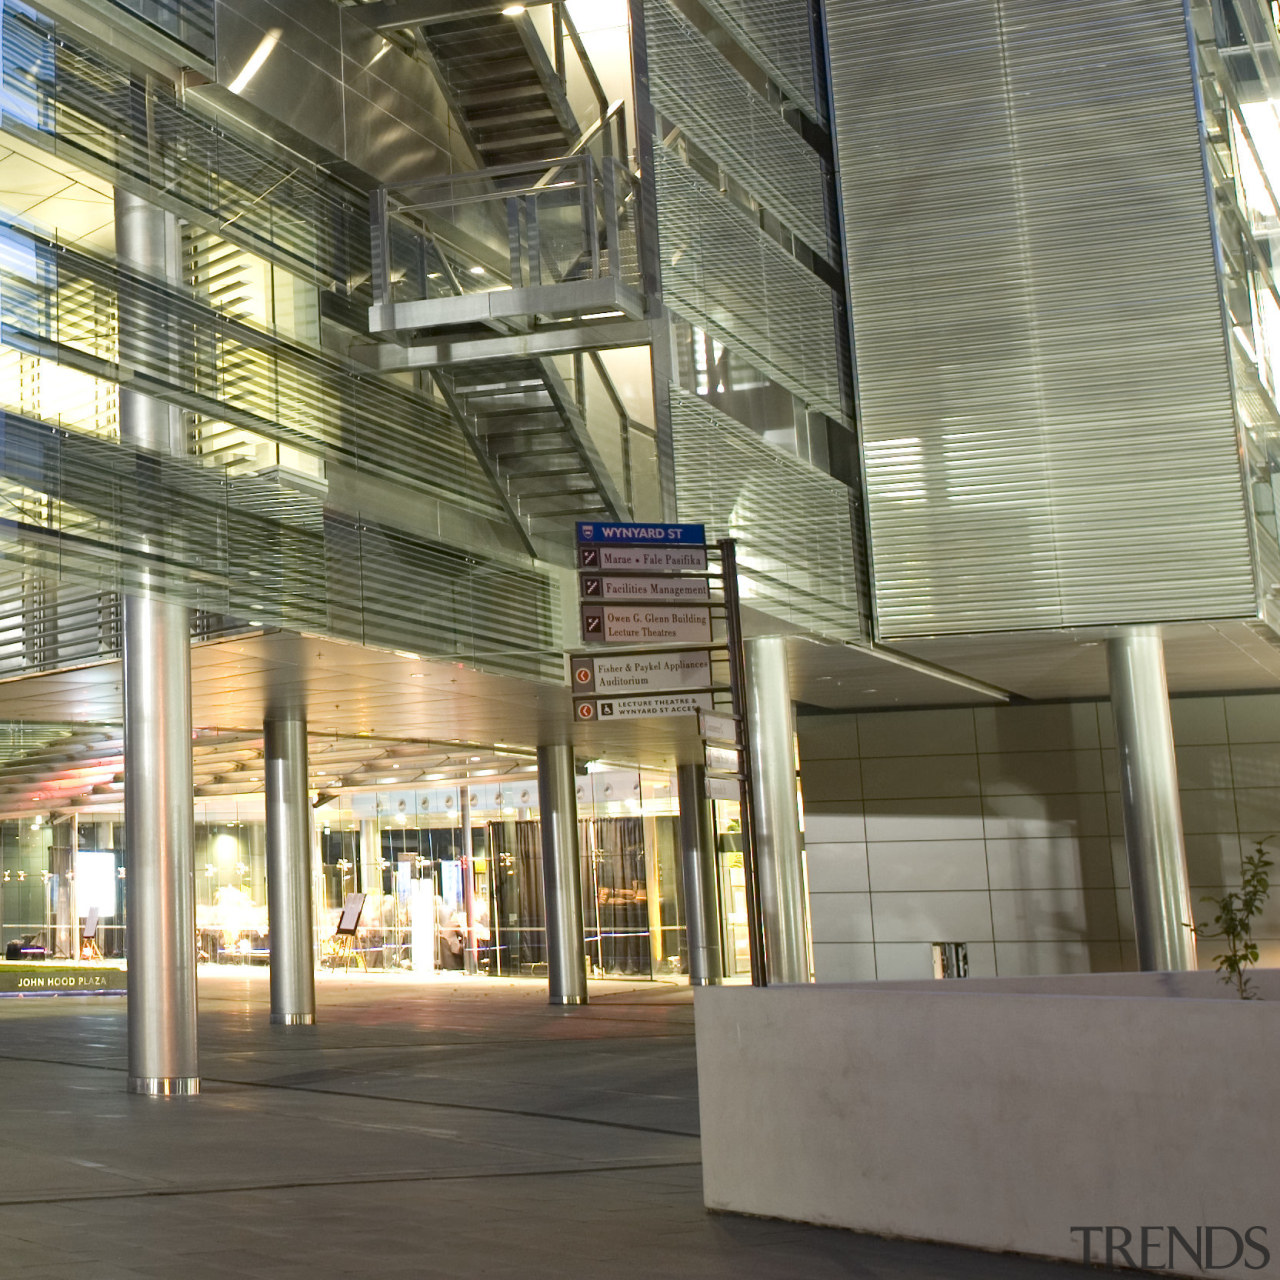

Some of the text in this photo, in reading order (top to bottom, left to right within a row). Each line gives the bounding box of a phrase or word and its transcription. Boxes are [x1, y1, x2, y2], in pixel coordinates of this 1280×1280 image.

[602, 527, 683, 539] WYNYARD ST
[604, 553, 701, 565] Marae Fale Pasifika
[606, 582, 707, 597] Facilities Management
[607, 613, 707, 626] Owen G. Glenn Building
[608, 627, 677, 637] Lecture Theatres
[598, 660, 708, 674] Fisher & Paykel Appliances
[599, 676, 649, 687] Auditorium
[618, 700, 652, 708] LECTURE
[654, 698, 690, 706] THEATRE
[619, 705, 697, 715] WYNYARD ST ACCES
[18, 976, 107, 987] JOHN HOOD PLAZA
